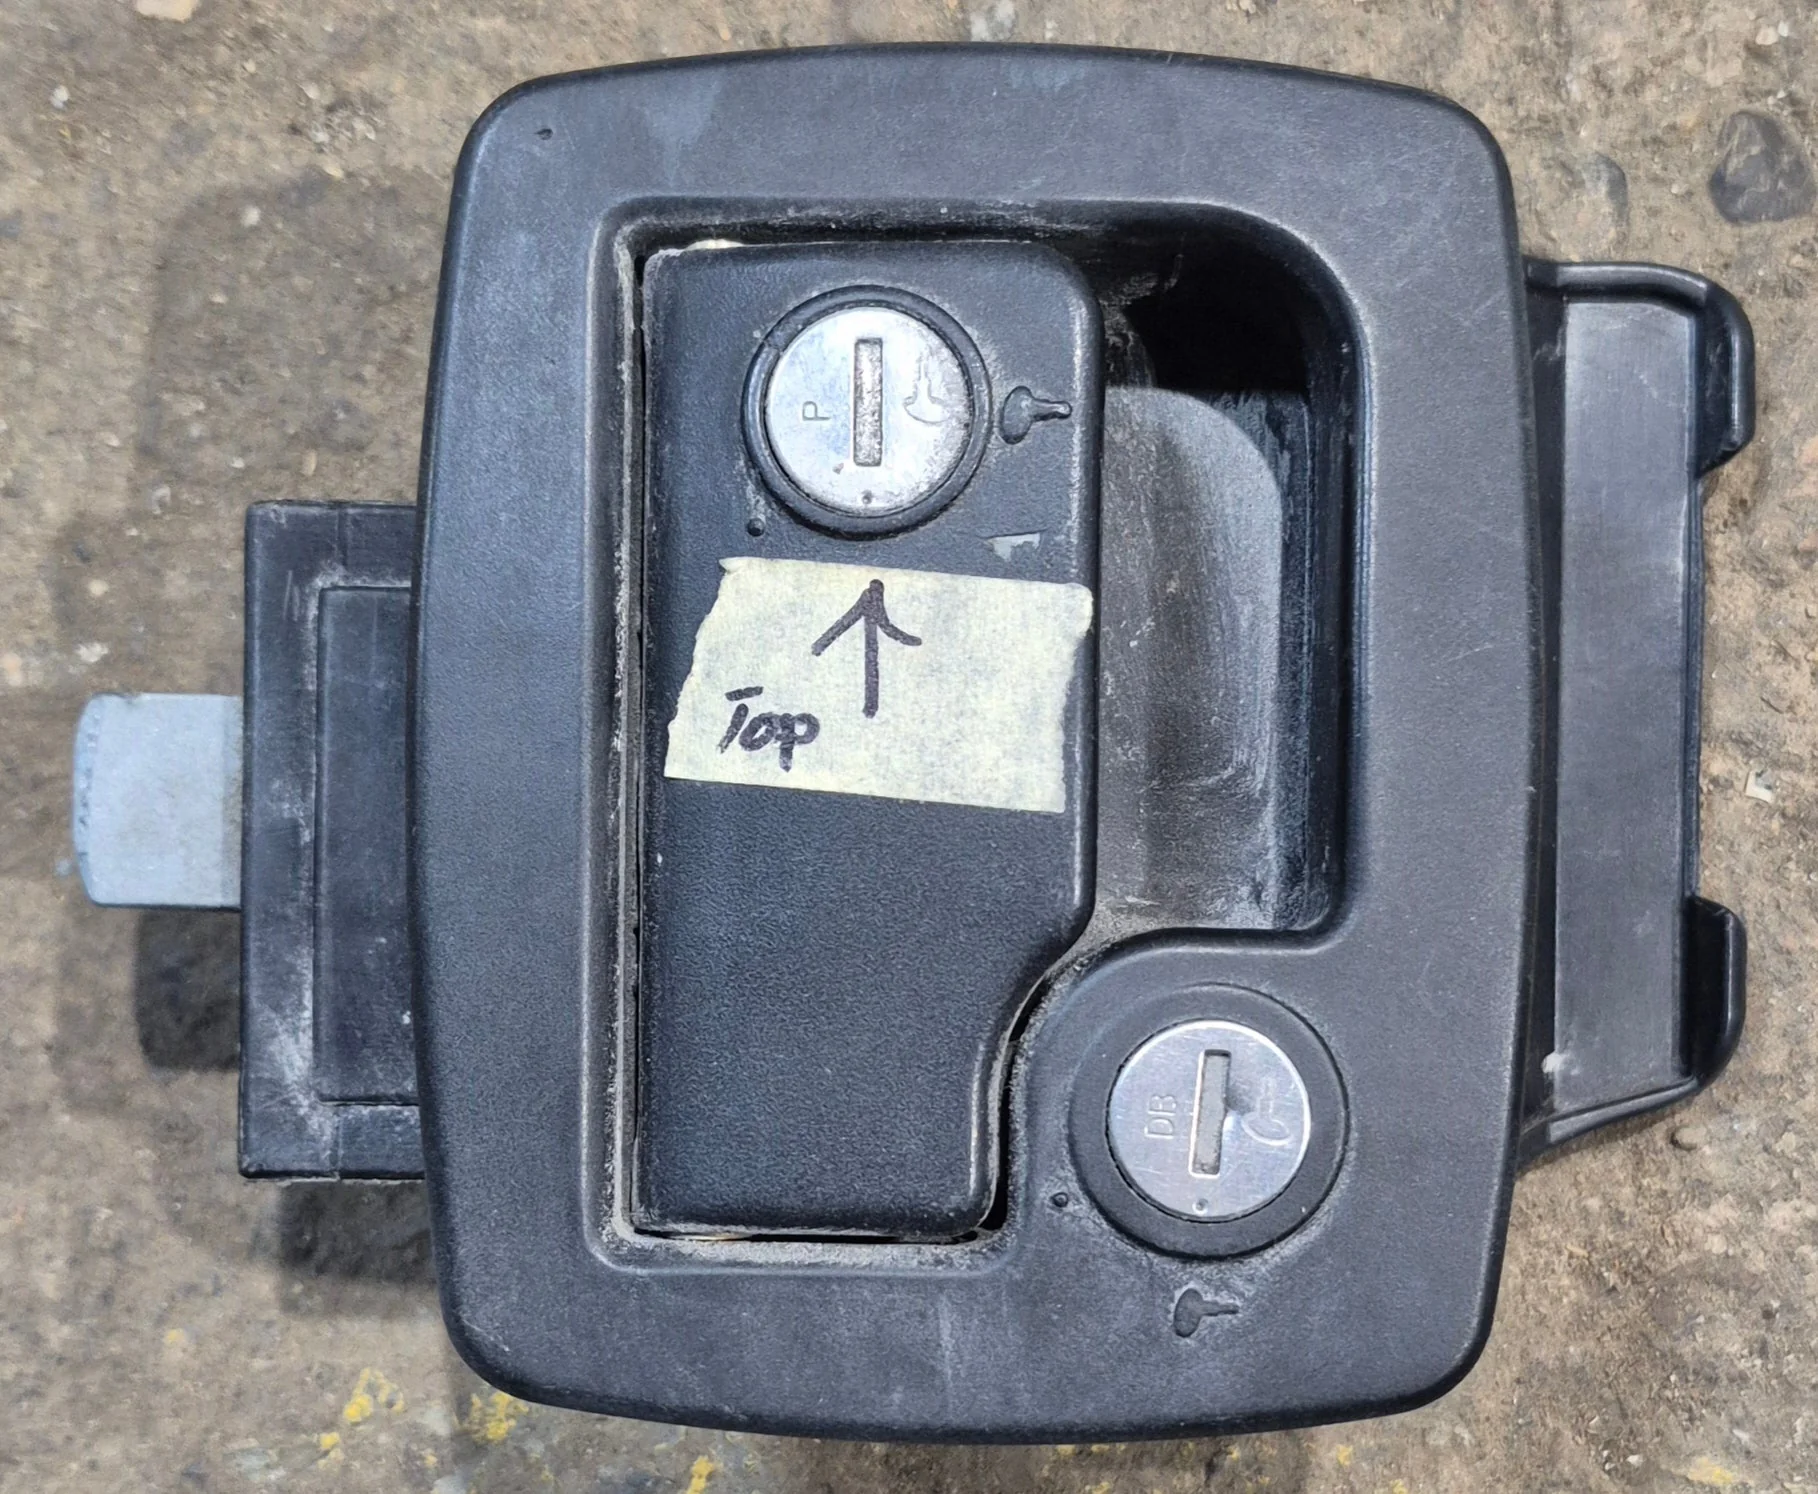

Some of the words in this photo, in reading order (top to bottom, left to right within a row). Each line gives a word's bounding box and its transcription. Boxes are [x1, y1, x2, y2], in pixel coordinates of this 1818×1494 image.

[801, 400, 831, 422] P
[717, 686, 821, 772] Top
[1143, 1094, 1178, 1140] DB
